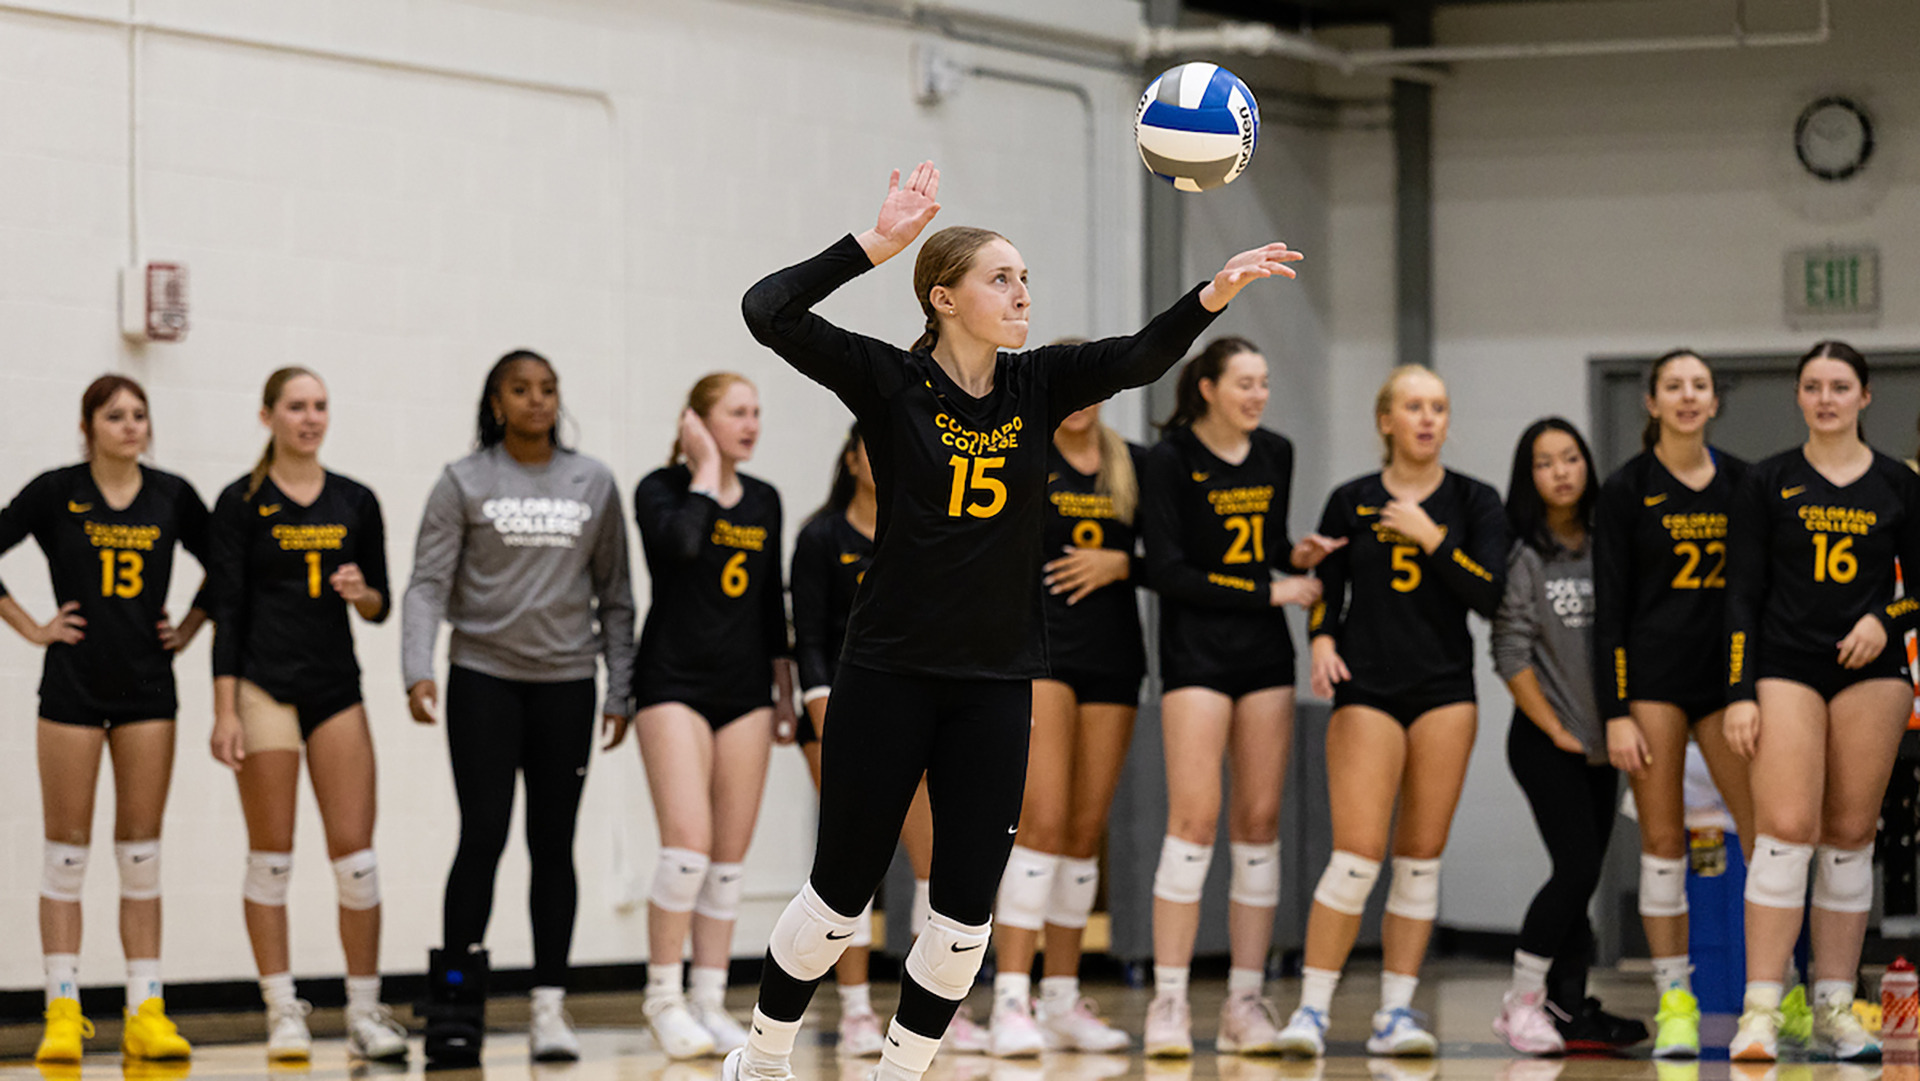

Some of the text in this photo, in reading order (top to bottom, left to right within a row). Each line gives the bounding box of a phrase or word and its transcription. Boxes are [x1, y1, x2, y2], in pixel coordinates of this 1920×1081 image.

[1234, 106, 1253, 174] molten
[1805, 255, 1859, 308] EXIT
[482, 497, 592, 521] COLORADO
[948, 454, 1007, 519] 15
[271, 523, 348, 540] COLORADO
[493, 517, 583, 536] COLLEGE
[1222, 514, 1265, 564] 21
[1661, 513, 1728, 530] COLORAD
[1798, 505, 1877, 526] COLORADO
[1804, 519, 1869, 536] COLLEGE
[278, 537, 343, 551] COLLEGE
[1671, 541, 1726, 589] 22
[1812, 532, 1859, 585] 16
[99, 548, 144, 600] 13
[304, 551, 322, 599] 1
[720, 551, 749, 598] 6
[1390, 544, 1422, 593] 5
